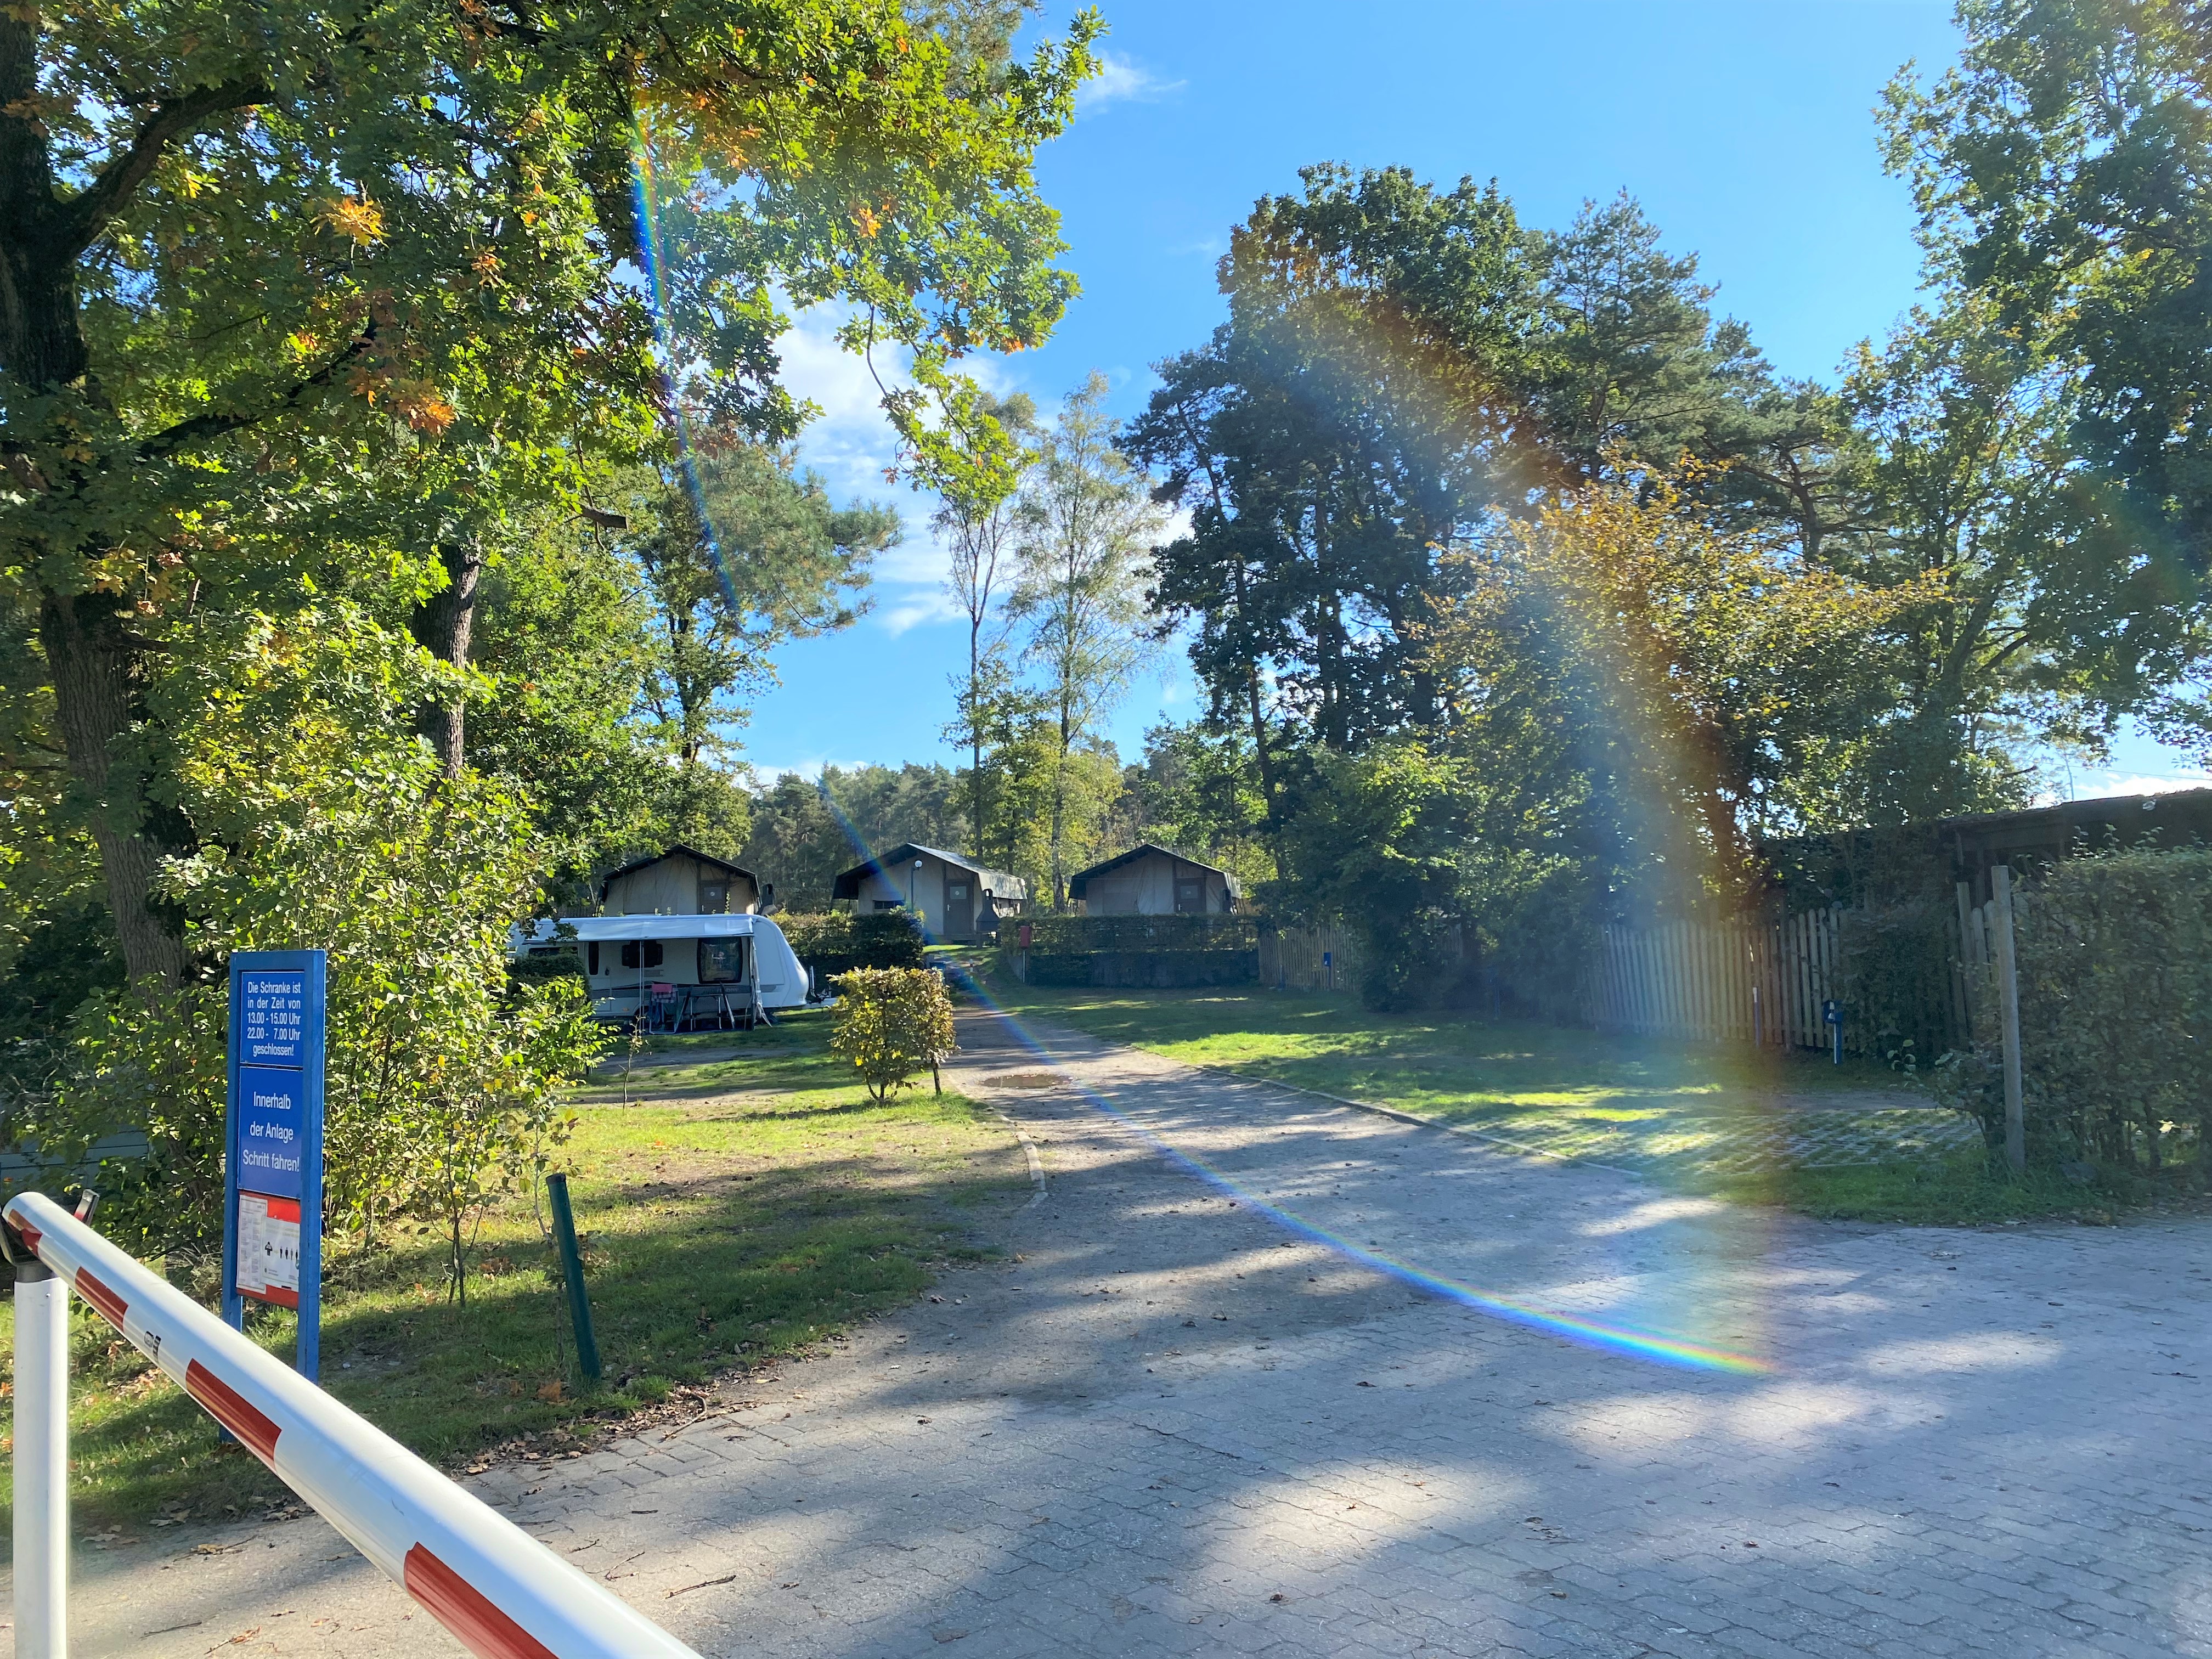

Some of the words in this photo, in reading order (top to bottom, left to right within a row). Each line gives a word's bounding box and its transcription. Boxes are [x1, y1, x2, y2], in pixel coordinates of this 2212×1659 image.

[248, 981, 258, 994] Die
[260, 981, 291, 994] Schranke
[292, 981, 301, 994] ist
[247, 997, 254, 1009] in
[257, 997, 268, 1009] der
[271, 997, 285, 1009] Zeit
[288, 1000, 301, 1009] von
[247, 1012, 264, 1024] 13.00
[270, 1013, 287, 1024] 15.00
[289, 1013, 301, 1025] Uhr
[247, 1027, 264, 1039] 22.00
[274, 1028, 287, 1040] 7.00
[289, 1028, 301, 1041] Uhr
[253, 1043, 294, 1057] geschlossen!
[253, 1091, 291, 1110] Innerhalb
[250, 1121, 264, 1137] der
[266, 1122, 294, 1144] Anlage
[242, 1149, 269, 1167] Schritt
[272, 1153, 300, 1172] fahren!
